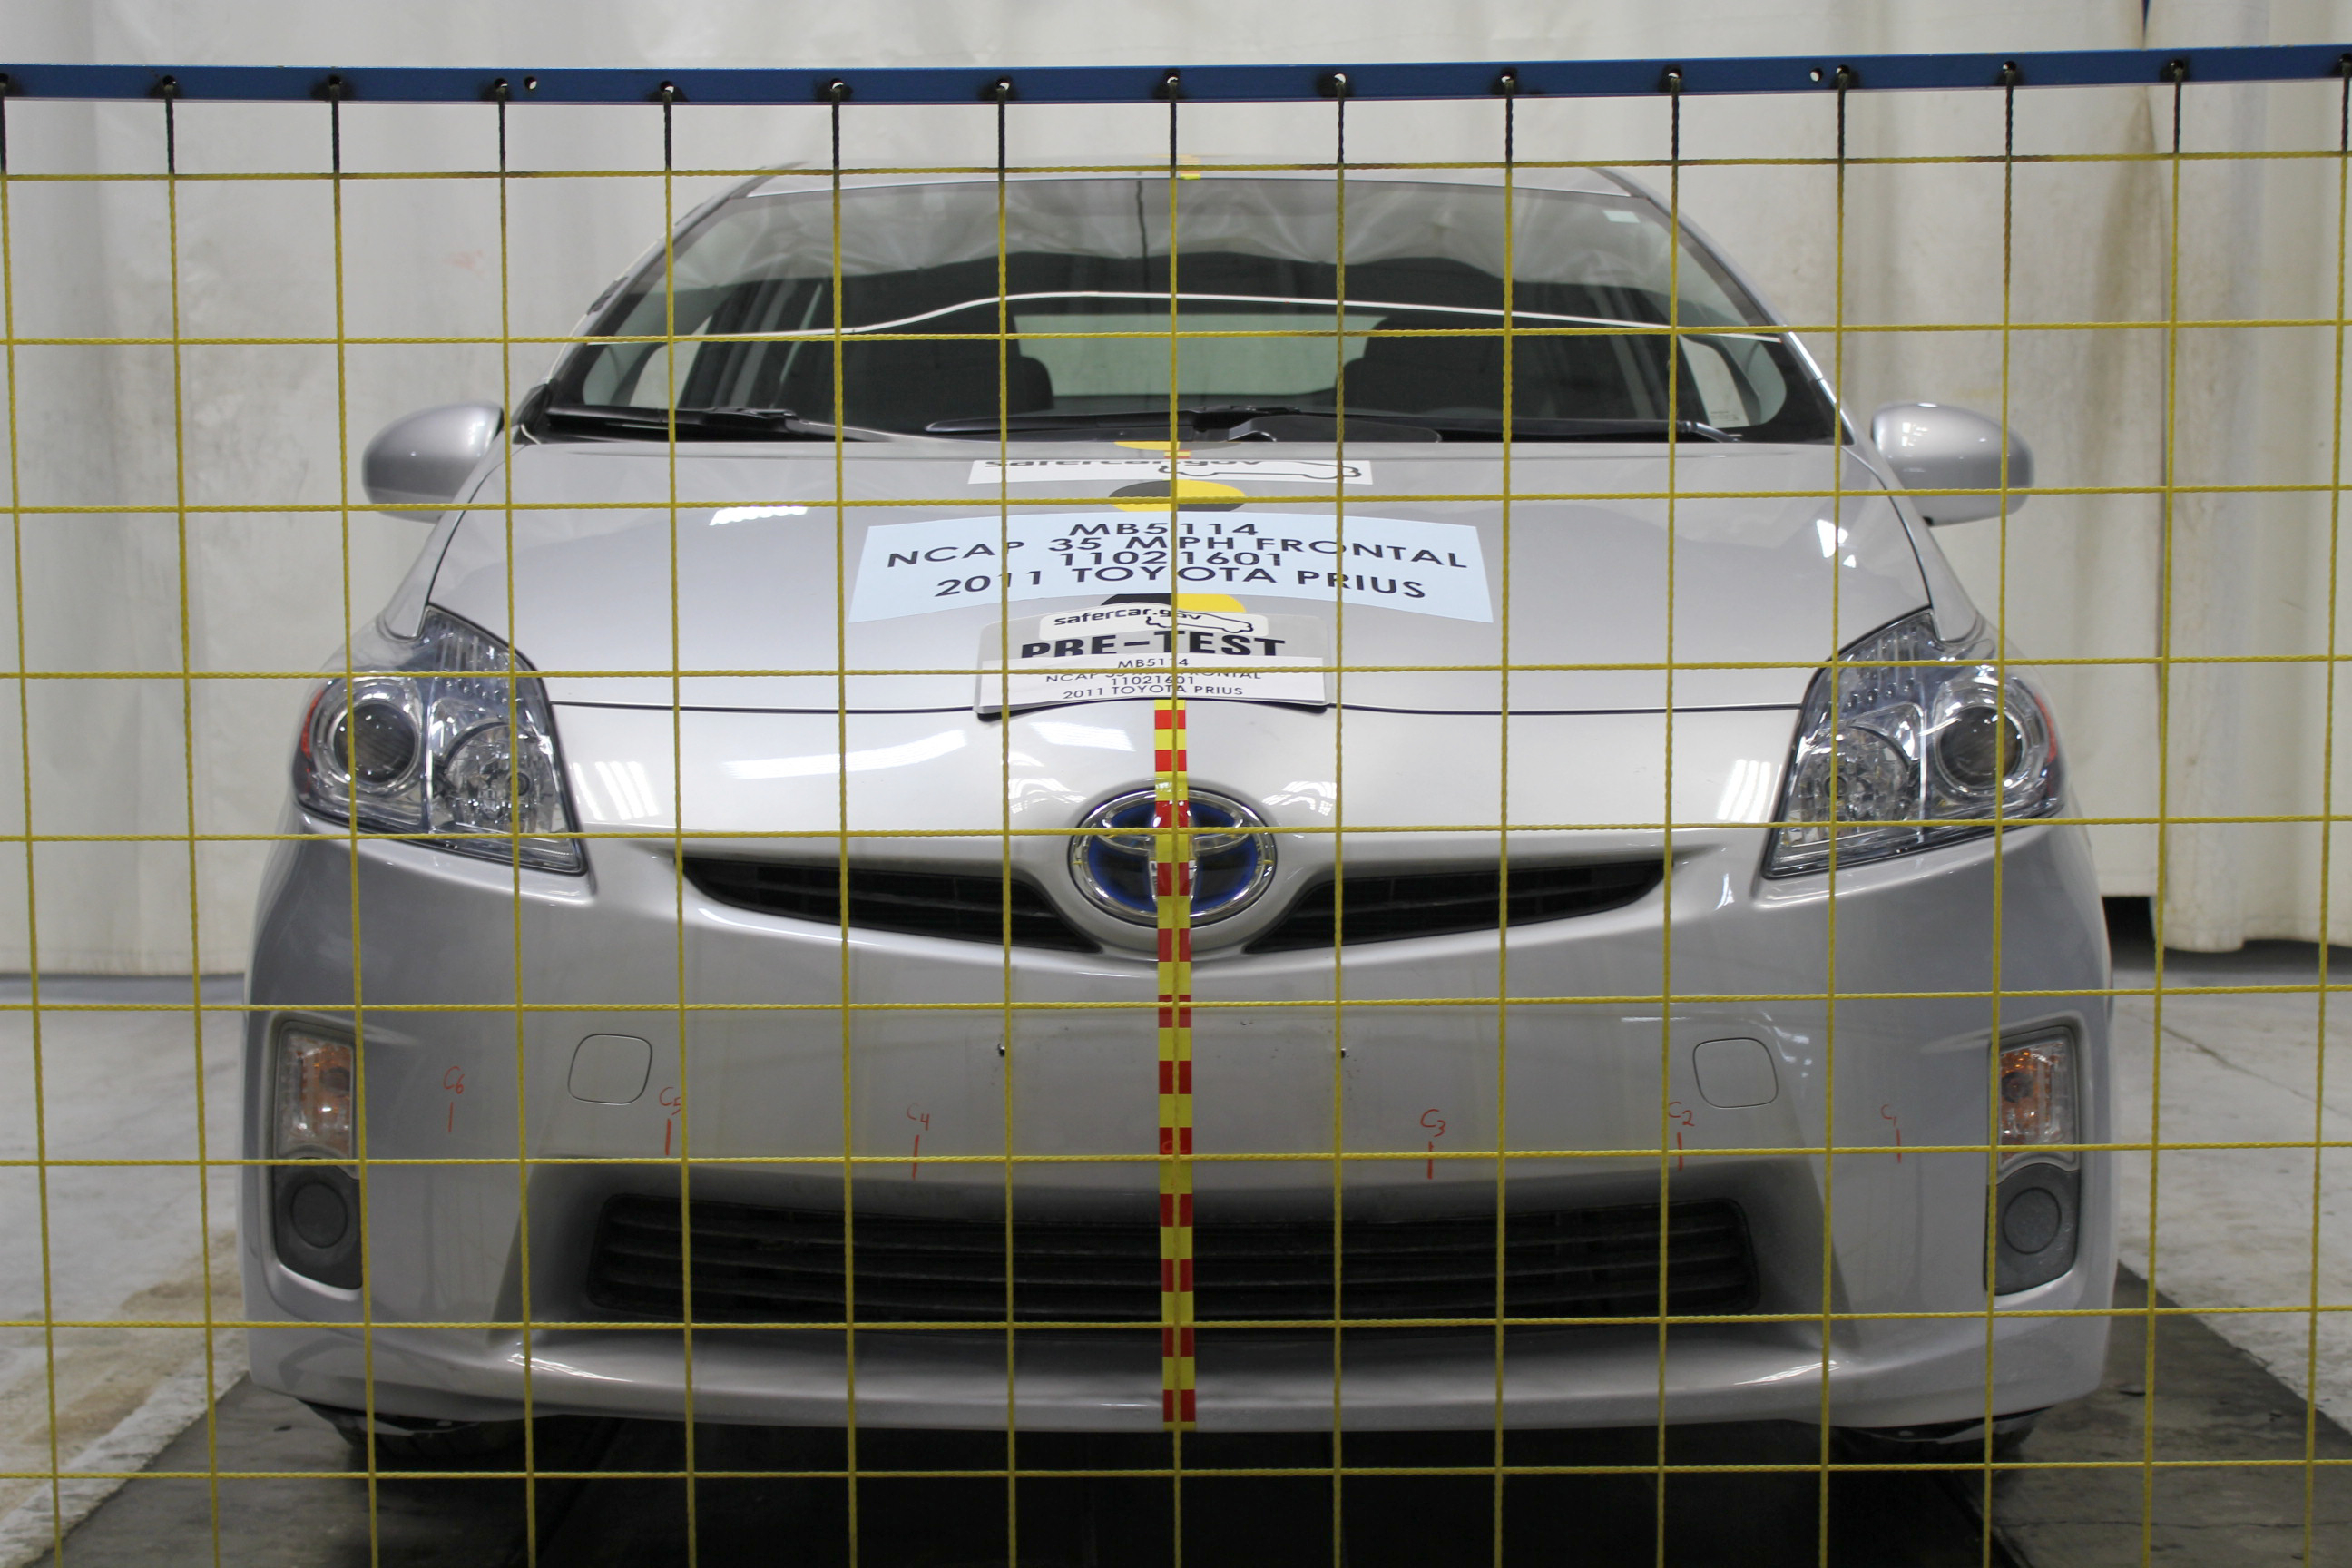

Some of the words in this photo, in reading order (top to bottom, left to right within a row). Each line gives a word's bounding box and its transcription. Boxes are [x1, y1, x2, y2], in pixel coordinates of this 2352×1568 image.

[1069, 523, 1258, 535] MB5114
[887, 541, 1024, 567] NCAP
[1048, 537, 1102, 551] 35
[1125, 536, 1234, 550] MPH
[1257, 537, 1467, 568] FRONTAL
[1060, 551, 1281, 566] 11021601
[934, 571, 1041, 597] 2011
[1072, 566, 1277, 583] TOYOTA
[1297, 570, 1426, 599] PRIUS
[1054, 608, 1202, 626] safercar.gov
[1021, 631, 1286, 659] PRE-TEST
[1117, 658, 1189, 669] MB514
[1111, 675, 1194, 686] 11021601
[1063, 688, 1103, 700] 2011
[1112, 684, 1187, 695] TOYOTA
[1194, 685, 1243, 696] PRIUS
